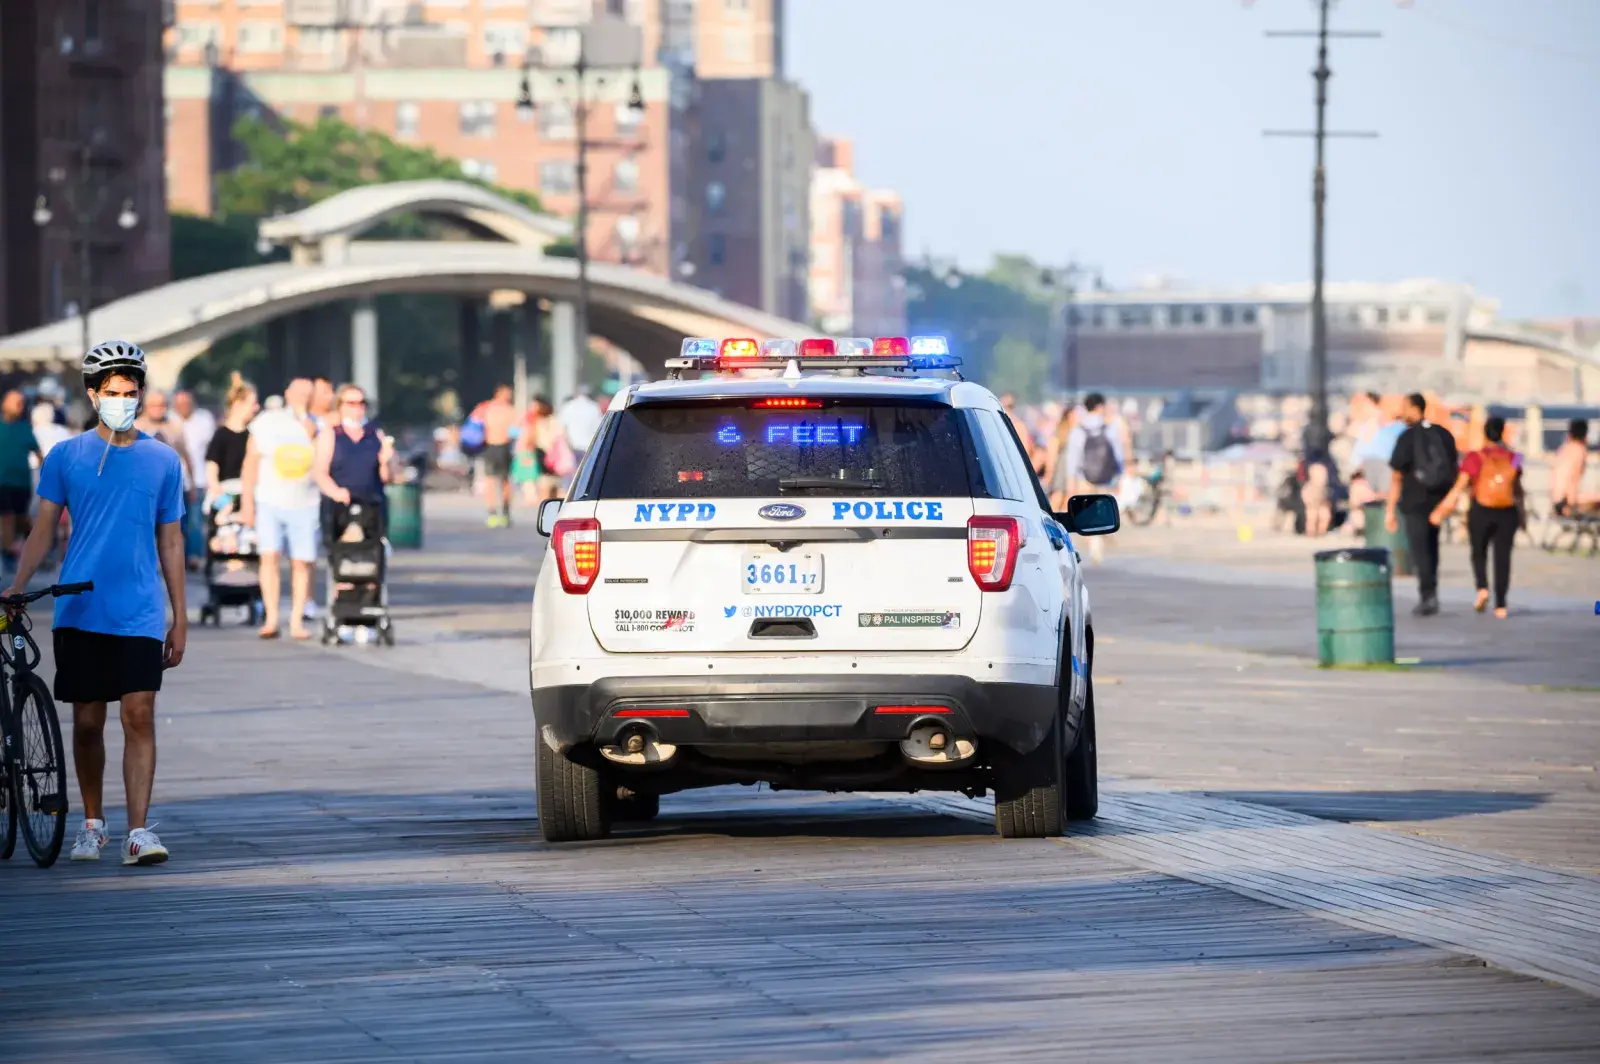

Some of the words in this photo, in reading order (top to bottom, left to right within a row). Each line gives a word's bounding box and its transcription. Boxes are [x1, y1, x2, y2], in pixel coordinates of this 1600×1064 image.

[768, 426, 863, 443] FEET
[634, 503, 716, 522] NYPD
[769, 505, 795, 517] Ford
[832, 501, 943, 520] POLICE
[747, 564, 797, 584] 3661
[801, 573, 817, 584] 17
[614, 609, 653, 621] $10,000
[741, 605, 843, 617] @NYPD70PCT
[884, 615, 900, 624] PAL
[901, 615, 942, 624] INSPIRES
[615, 624, 630, 632] CALL
